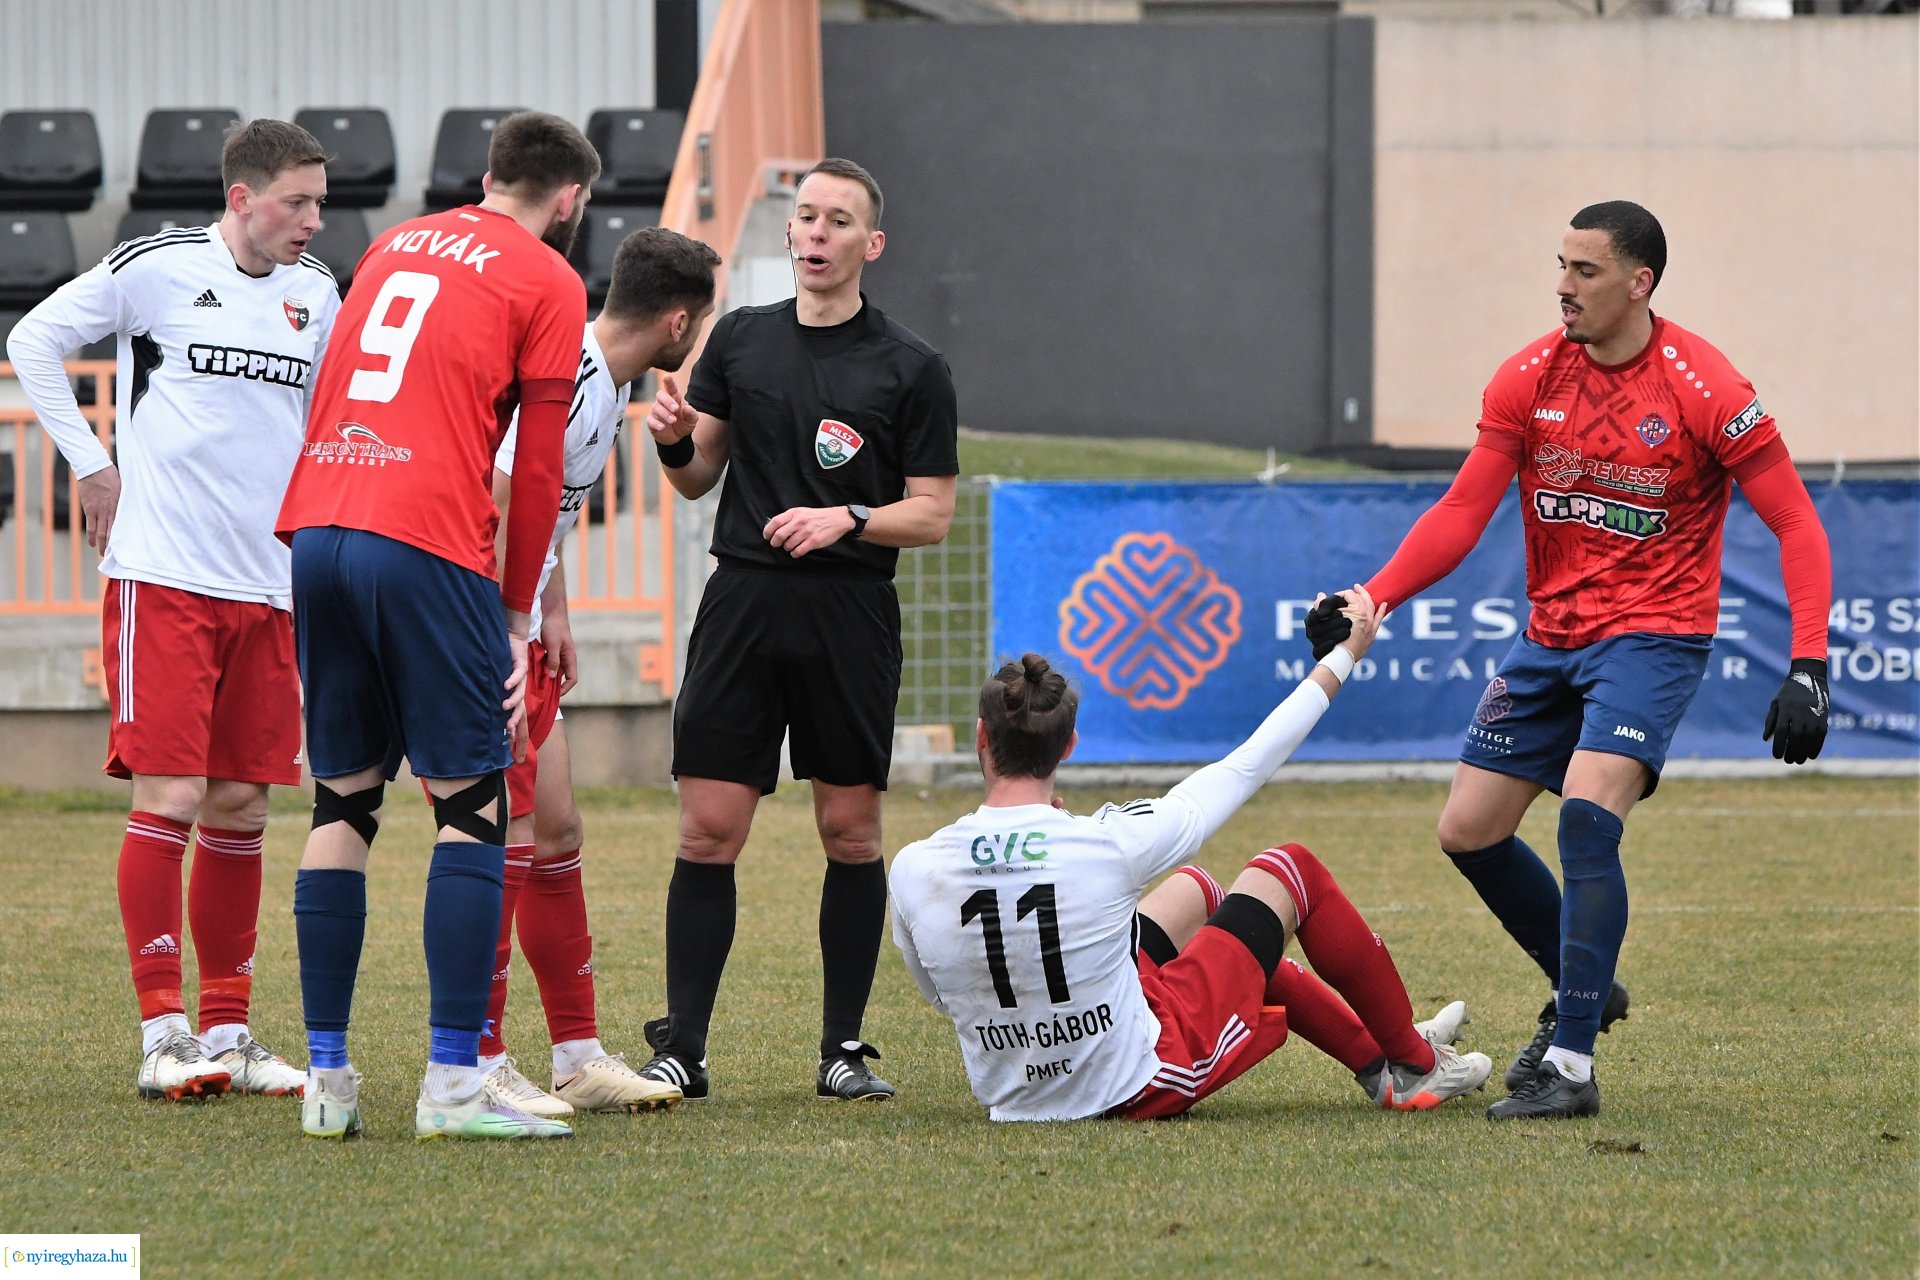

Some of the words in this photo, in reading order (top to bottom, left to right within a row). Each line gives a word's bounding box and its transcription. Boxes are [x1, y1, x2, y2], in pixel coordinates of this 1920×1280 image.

[383, 230, 501, 275] NOVÁK
[193, 300, 222, 308] adidas
[287, 310, 307, 321] MFC
[347, 270, 440, 404] 9
[1534, 408, 1565, 422] JAKO
[829, 426, 854, 442] MLSZ
[360, 443, 412, 462] TRANS
[1581, 459, 1670, 487] REVESZ
[1613, 725, 1645, 742] JAKO
[971, 831, 1049, 866] GVC
[976, 864, 1047, 876] GROUP
[140, 945, 179, 954] adidas
[960, 883, 1071, 1009] 11
[1564, 989, 1599, 1000] JAKO
[976, 1003, 1114, 1052] TÓTH-GÁBOR
[1026, 1058, 1073, 1082] PMFC
